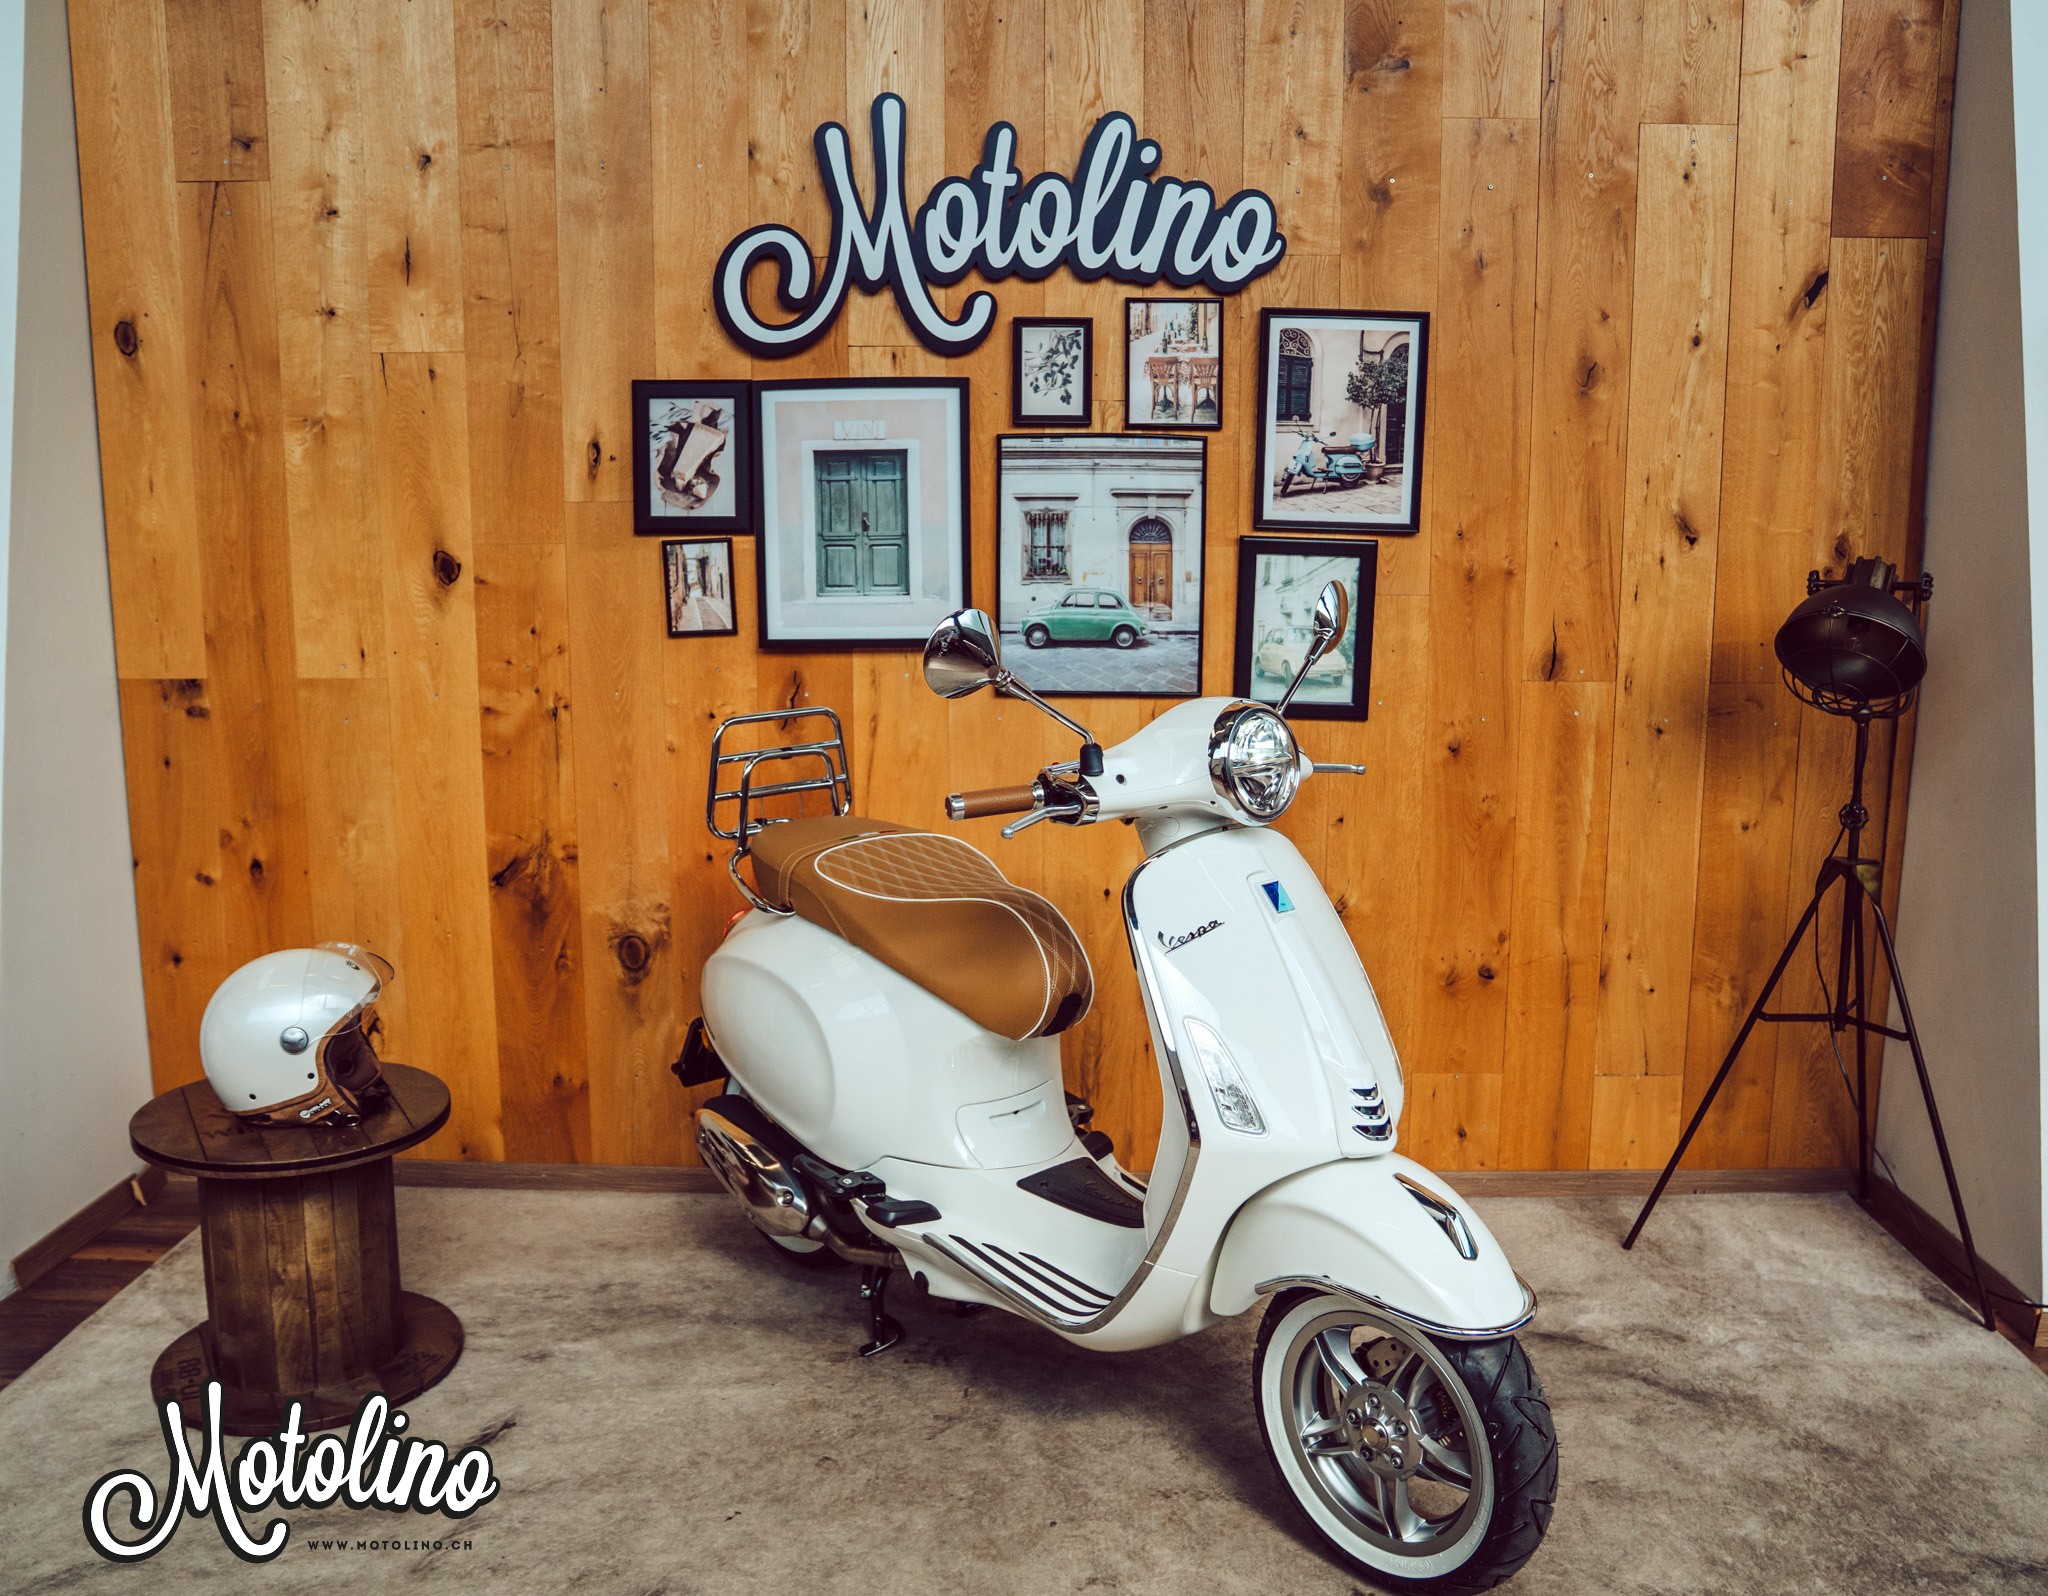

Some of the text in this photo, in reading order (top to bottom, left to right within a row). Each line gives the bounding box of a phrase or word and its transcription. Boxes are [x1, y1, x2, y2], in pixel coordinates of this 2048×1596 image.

[724, 97, 1282, 344] Motolino
[842, 422, 881, 438] VINI
[1157, 919, 1226, 956] Vespa
